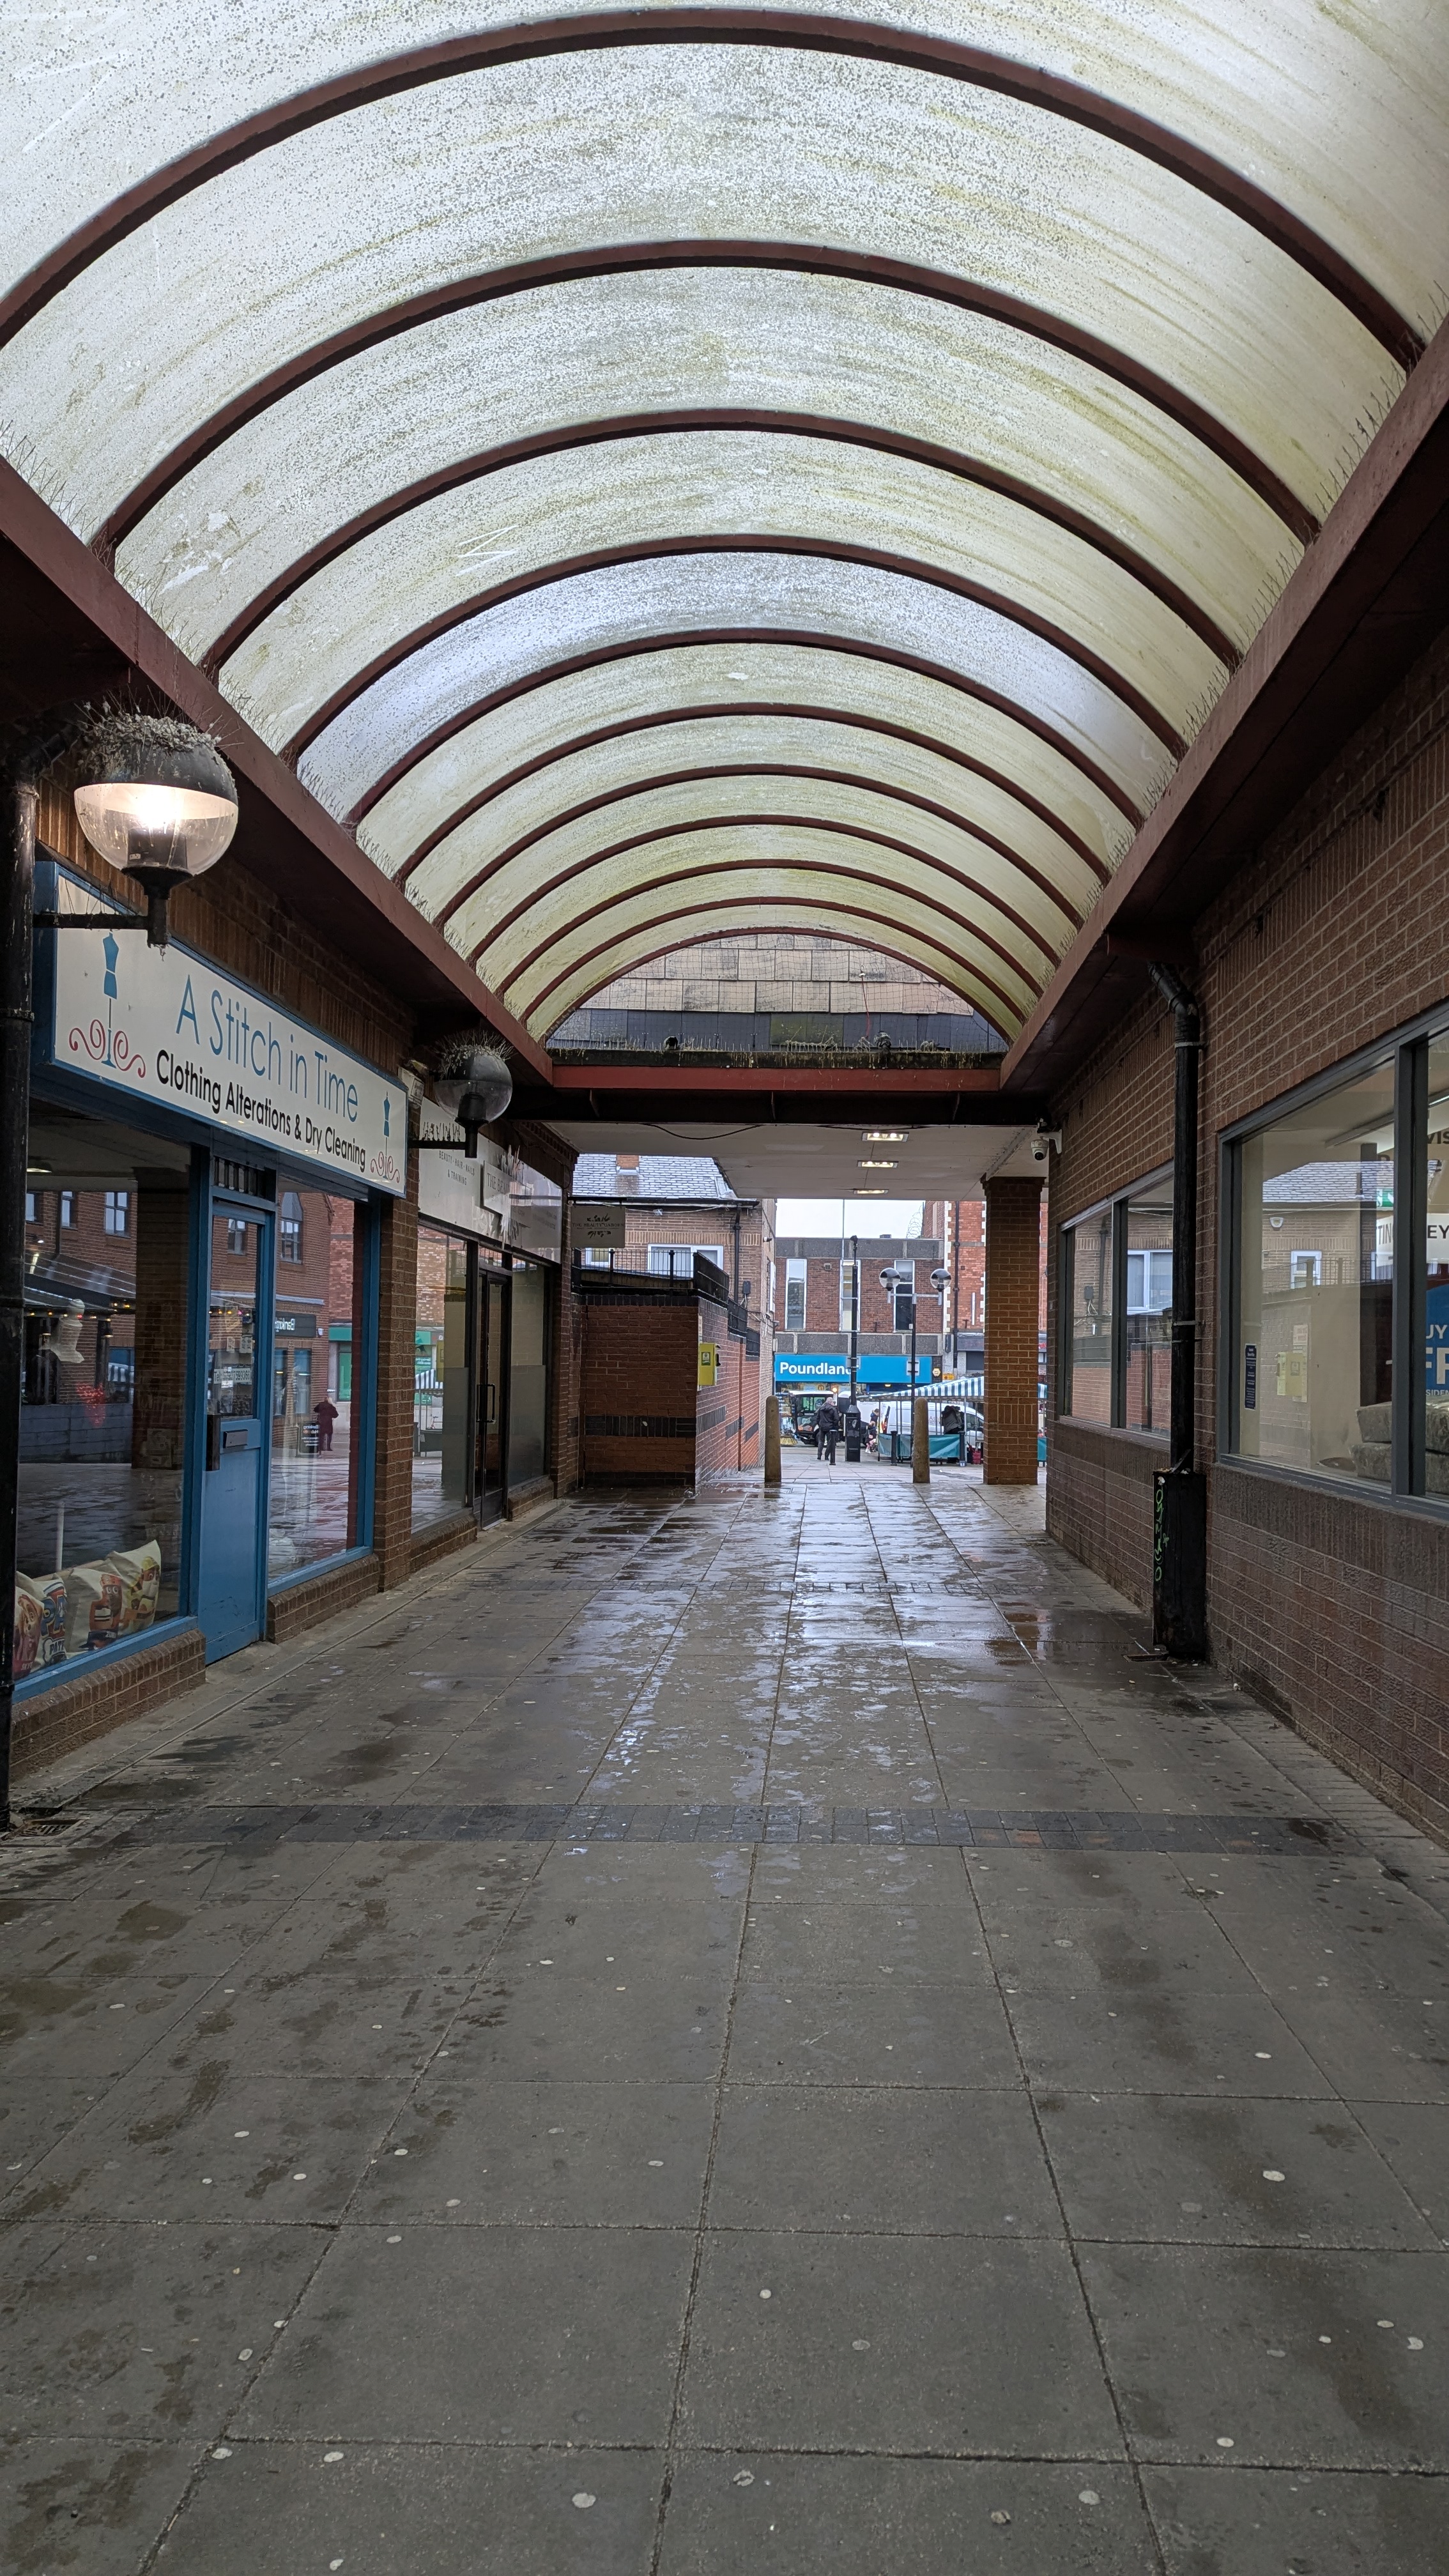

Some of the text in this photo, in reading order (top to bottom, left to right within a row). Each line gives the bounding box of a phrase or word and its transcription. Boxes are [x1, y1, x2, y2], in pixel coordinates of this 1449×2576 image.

[176, 974, 358, 1123] A Stitch in Time
[157, 1049, 366, 1173] Clothing Alterations & Dry Cleaning
[438, 1150, 475, 1176] BEAUTY HAIR NAILS
[450, 1170, 467, 1186] TRAINING
[487, 1172, 496, 1190] THE
